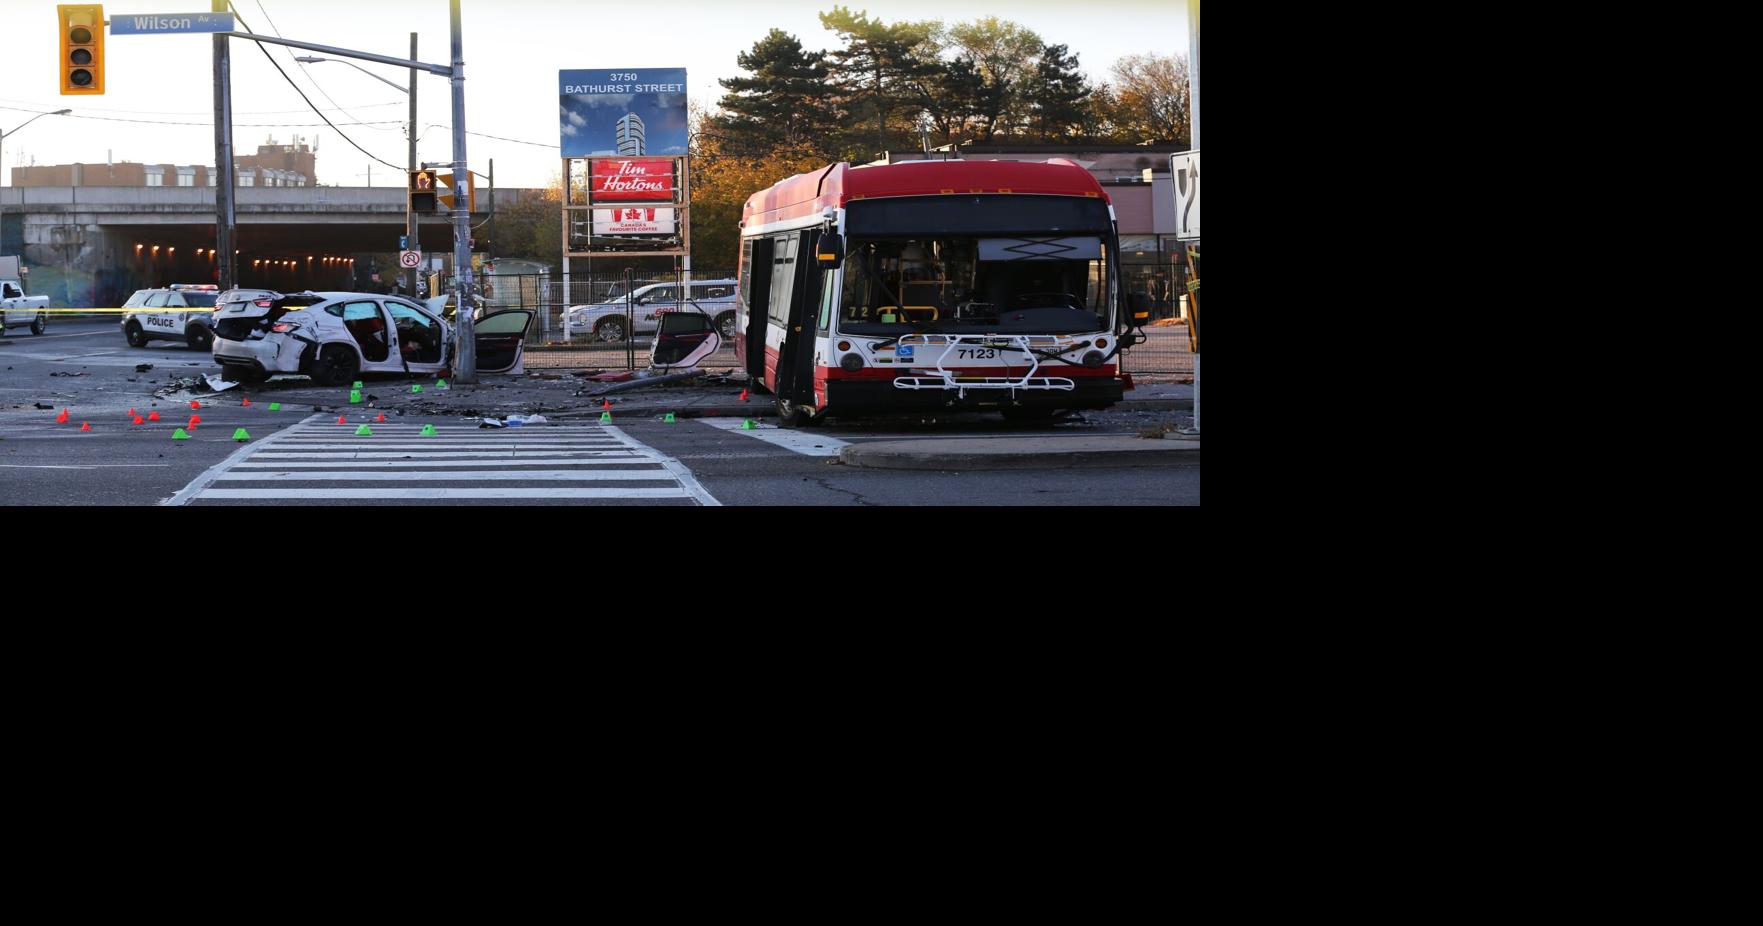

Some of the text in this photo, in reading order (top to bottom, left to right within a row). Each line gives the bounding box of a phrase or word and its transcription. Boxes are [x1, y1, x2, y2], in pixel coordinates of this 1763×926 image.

[134, 15, 209, 30] Wilson Av
[610, 73, 638, 81] 3750
[565, 83, 684, 94] BATHURST STREET
[617, 160, 646, 175] Tim
[603, 175, 663, 190] Hortons
[147, 316, 174, 328] POLICE
[958, 349, 995, 360] 7123
